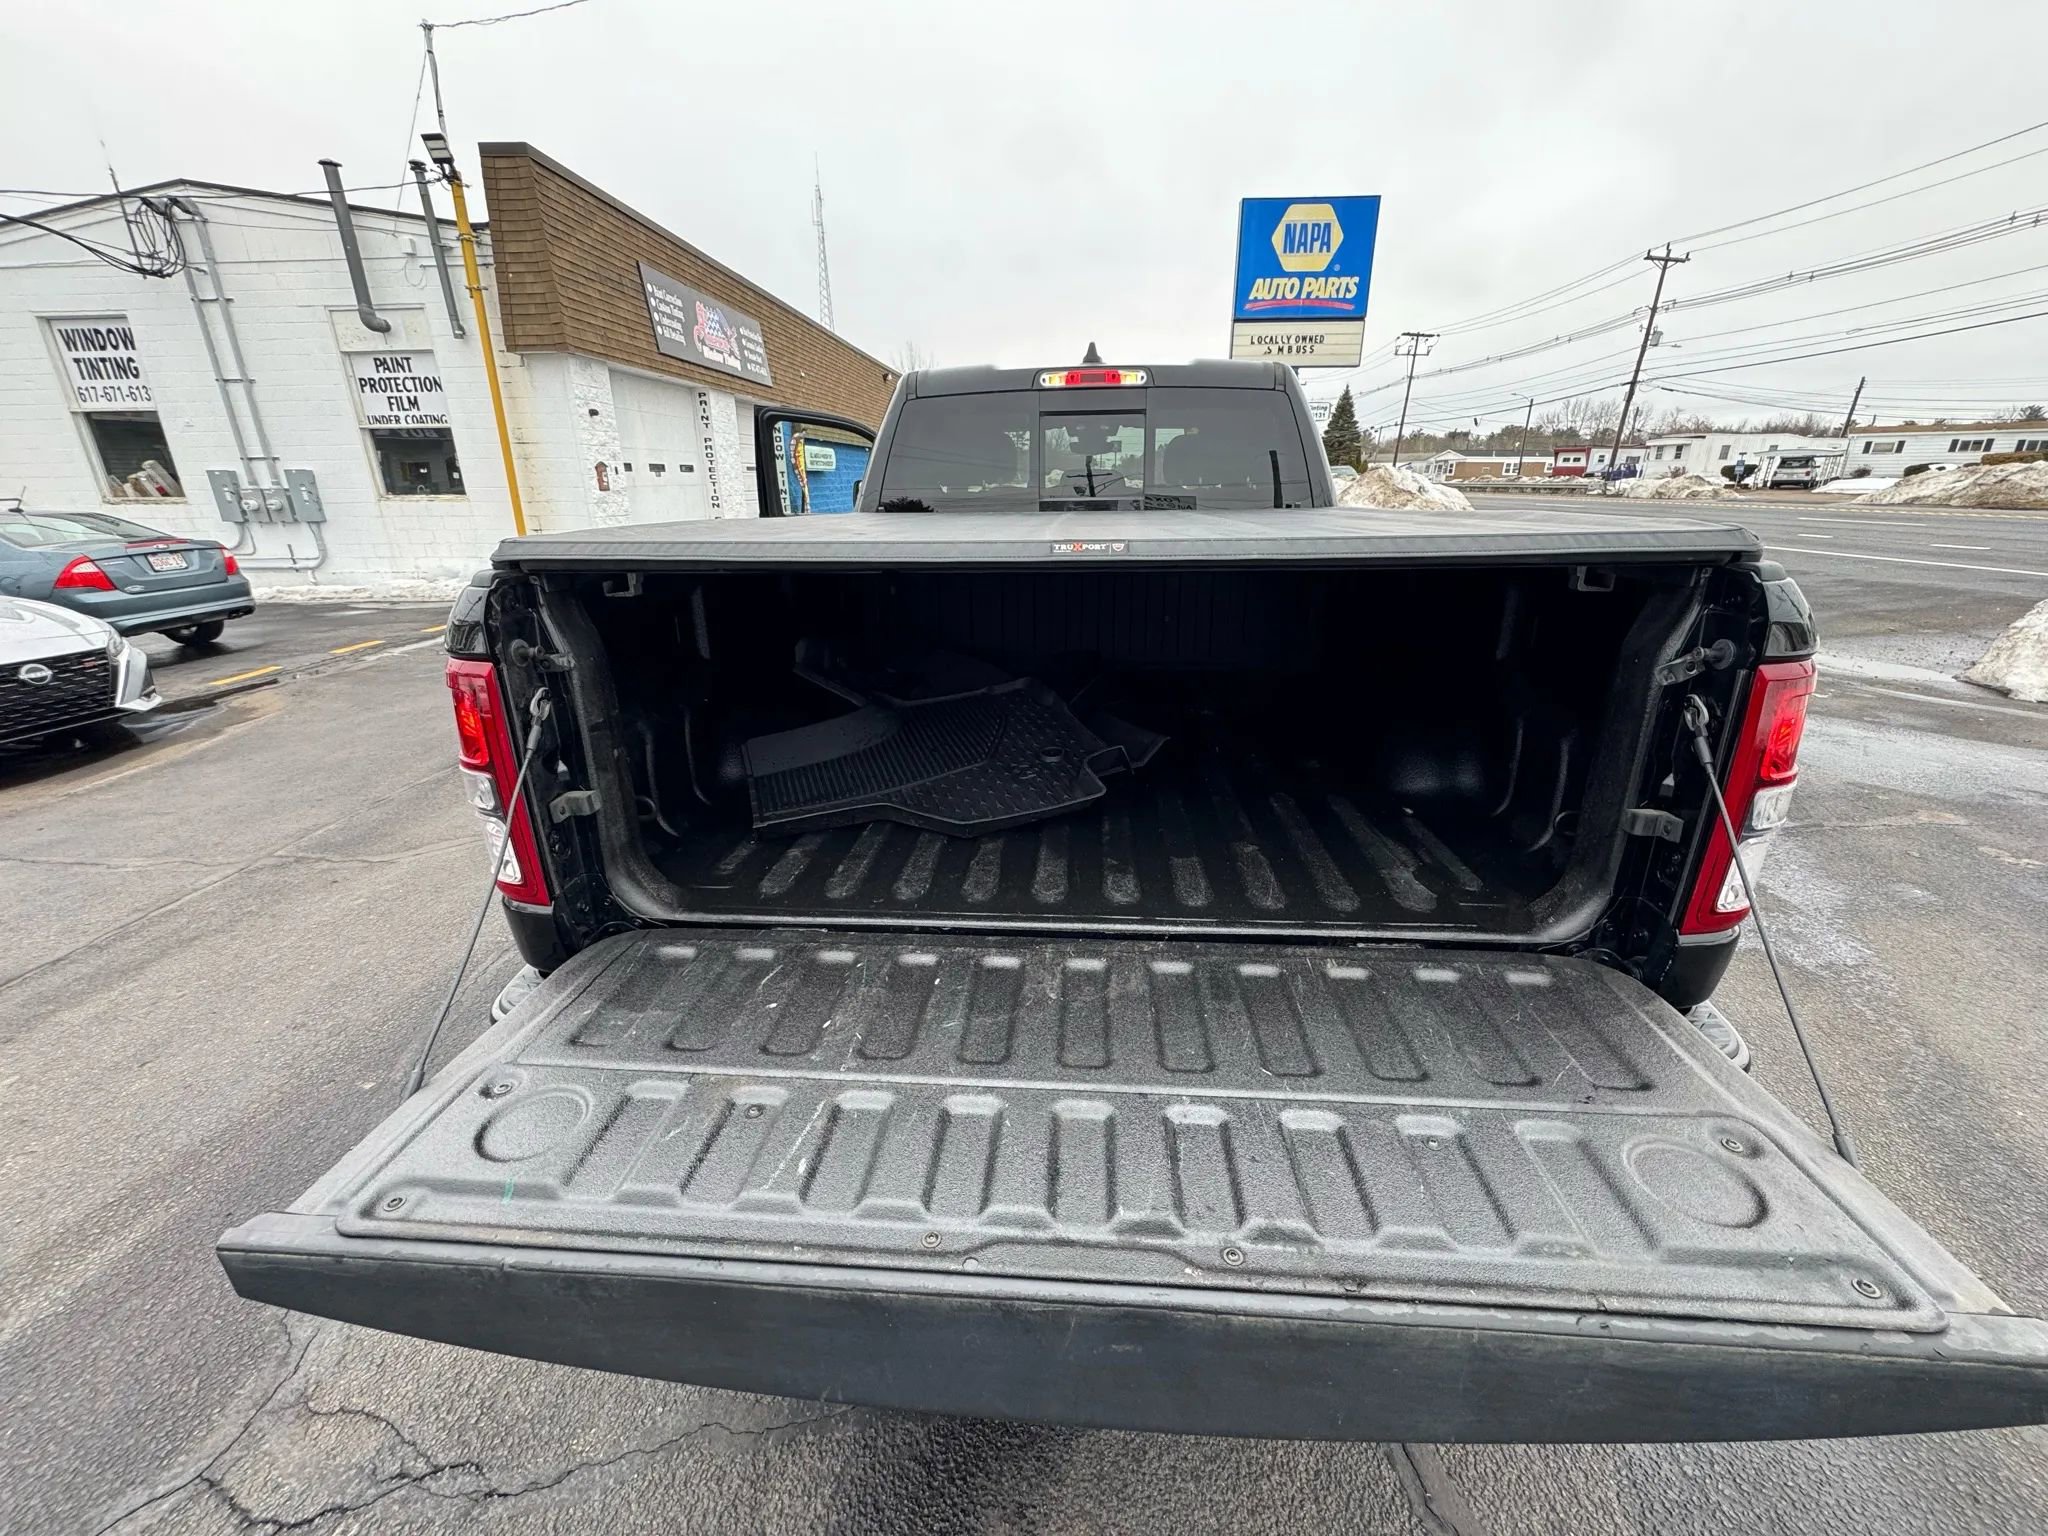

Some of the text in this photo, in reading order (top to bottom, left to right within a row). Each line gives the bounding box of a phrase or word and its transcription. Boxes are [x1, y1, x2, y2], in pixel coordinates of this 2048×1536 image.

[1283, 222, 1332, 254] NAPA
[1249, 276, 1360, 300] AUTO PARTS
[57, 327, 136, 352] WINDOW
[1250, 334, 1325, 345] LOCALLY OWNED
[72, 356, 140, 381] TINTING
[373, 356, 413, 374] PAINT
[77, 385, 152, 403] 617-671-613
[358, 376, 444, 393] PROTECTION
[387, 395, 421, 412] FILM
[698, 392, 711, 429] PAINT
[367, 414, 448, 425] UNDER COATING
[773, 426, 784, 461] NDOW
[704, 437, 720, 509] PROTECTION
[1053, 543, 1107, 551] TRUXPORT
